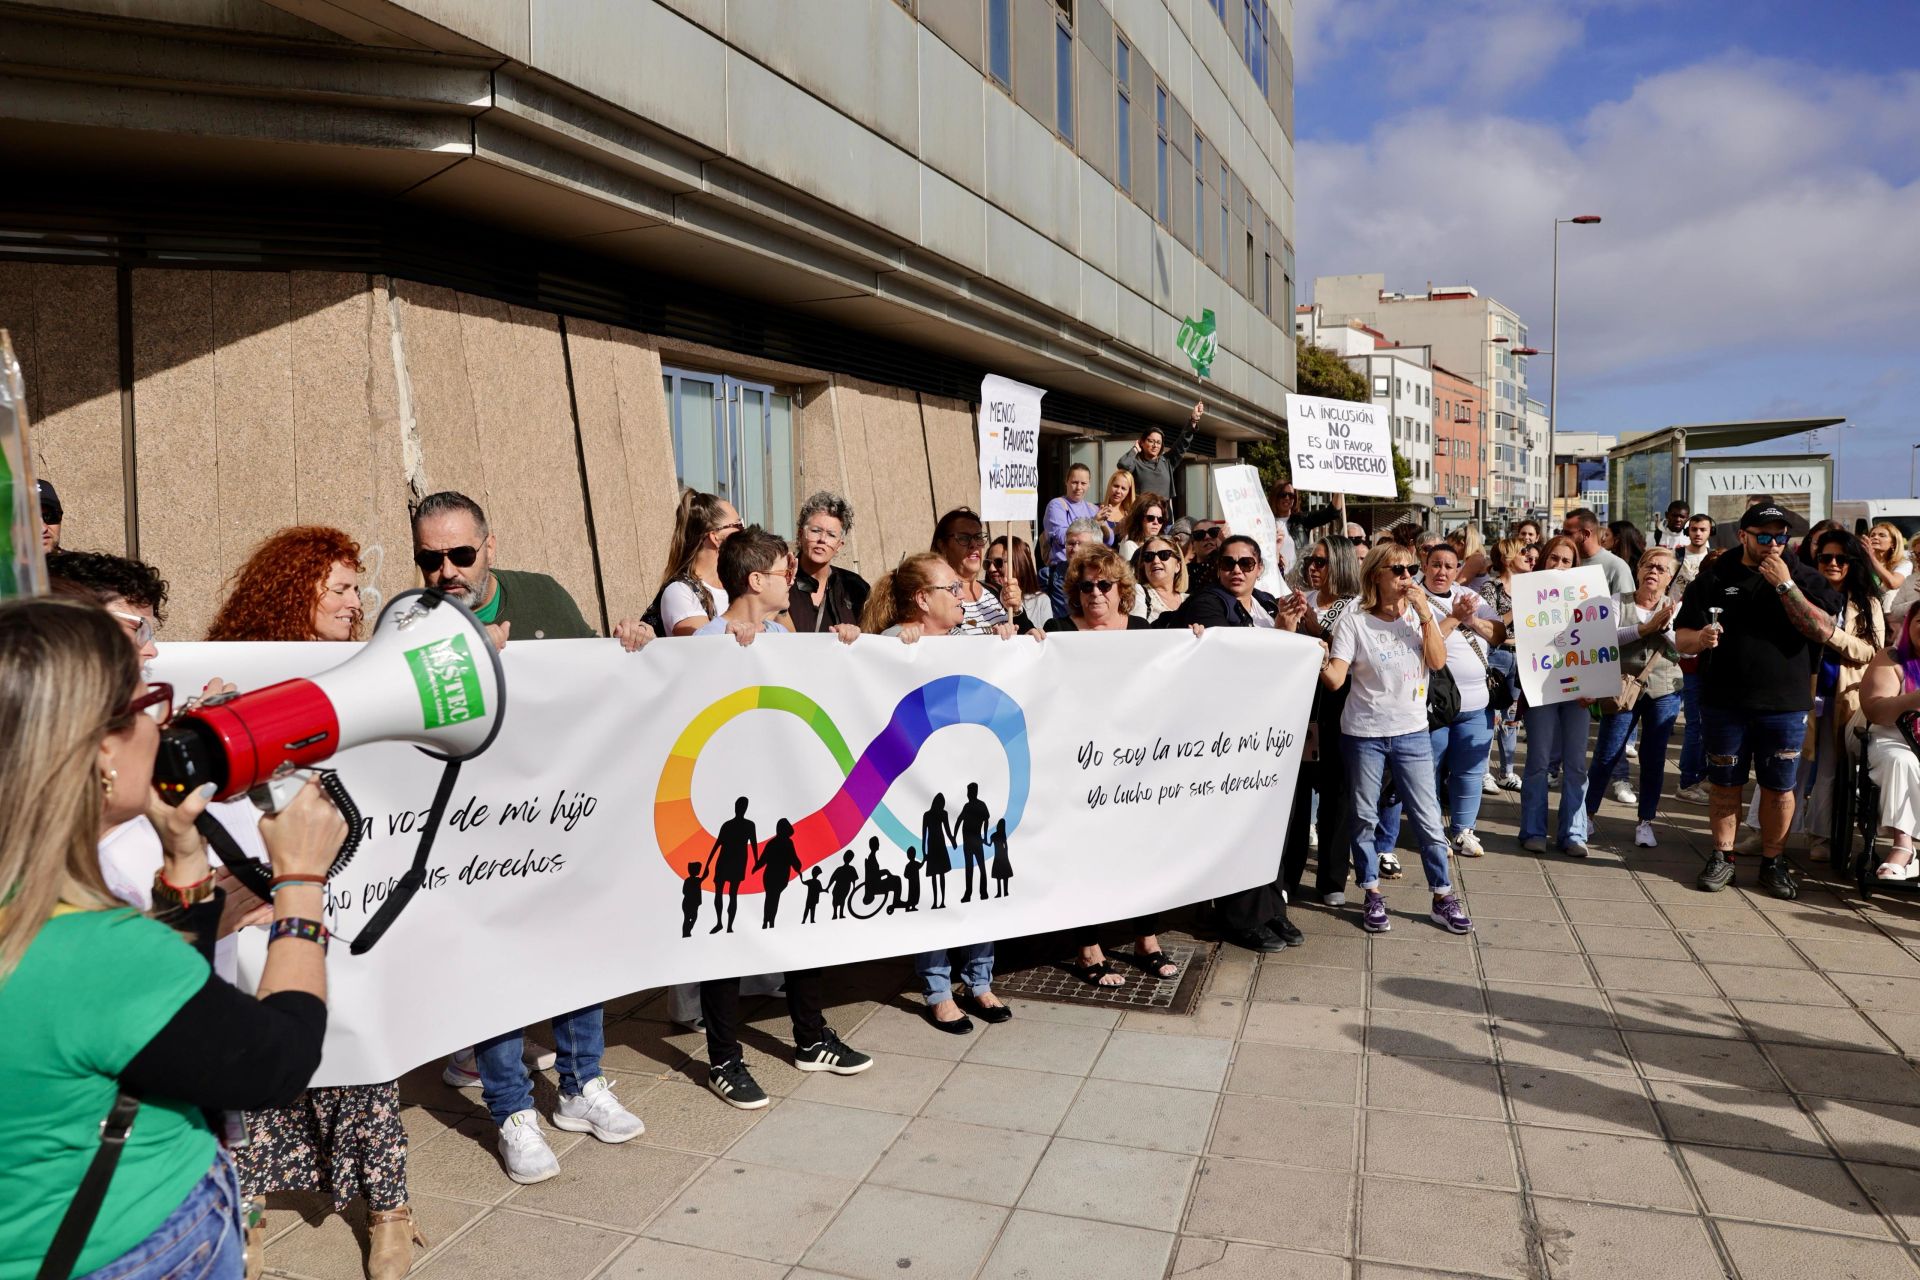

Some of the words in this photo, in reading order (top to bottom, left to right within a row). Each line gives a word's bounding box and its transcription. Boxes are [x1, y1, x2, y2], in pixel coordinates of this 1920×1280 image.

[990, 401, 1016, 423] MENOS
[1300, 404, 1315, 419] LA
[1003, 426, 1034, 453] FAVORES
[1328, 422, 1350, 438] NO
[1308, 436, 1322, 448] ES
[1326, 439, 1340, 450] UN
[1344, 440, 1374, 453] FAVOR
[1297, 454, 1314, 469] ES
[1319, 460, 1333, 469] UN
[1335, 455, 1386, 473] DERECHO
[1005, 464, 1038, 488] DERECHOS
[1710, 473, 1812, 490] VALENTINO
[1537, 588, 1560, 605] NO
[1563, 585, 1589, 601] ES
[1553, 629, 1580, 647] ES
[1077, 740, 1104, 770] Yo
[1113, 746, 1147, 767] soy
[1152, 737, 1170, 761] la
[1176, 740, 1205, 758] voz
[1211, 731, 1233, 757] de
[1238, 731, 1260, 753] mi
[1266, 727, 1294, 757] hijo
[1087, 785, 1108, 809] Yo
[1113, 782, 1153, 805] lucho
[1157, 783, 1185, 805] por
[1190, 780, 1215, 798] sus
[1220, 770, 1279, 795] derechos
[449, 796, 492, 832] de
[499, 797, 541, 826] mi
[550, 790, 597, 832] hijo
[420, 866, 450, 891] us
[458, 848, 566, 885] derechos
